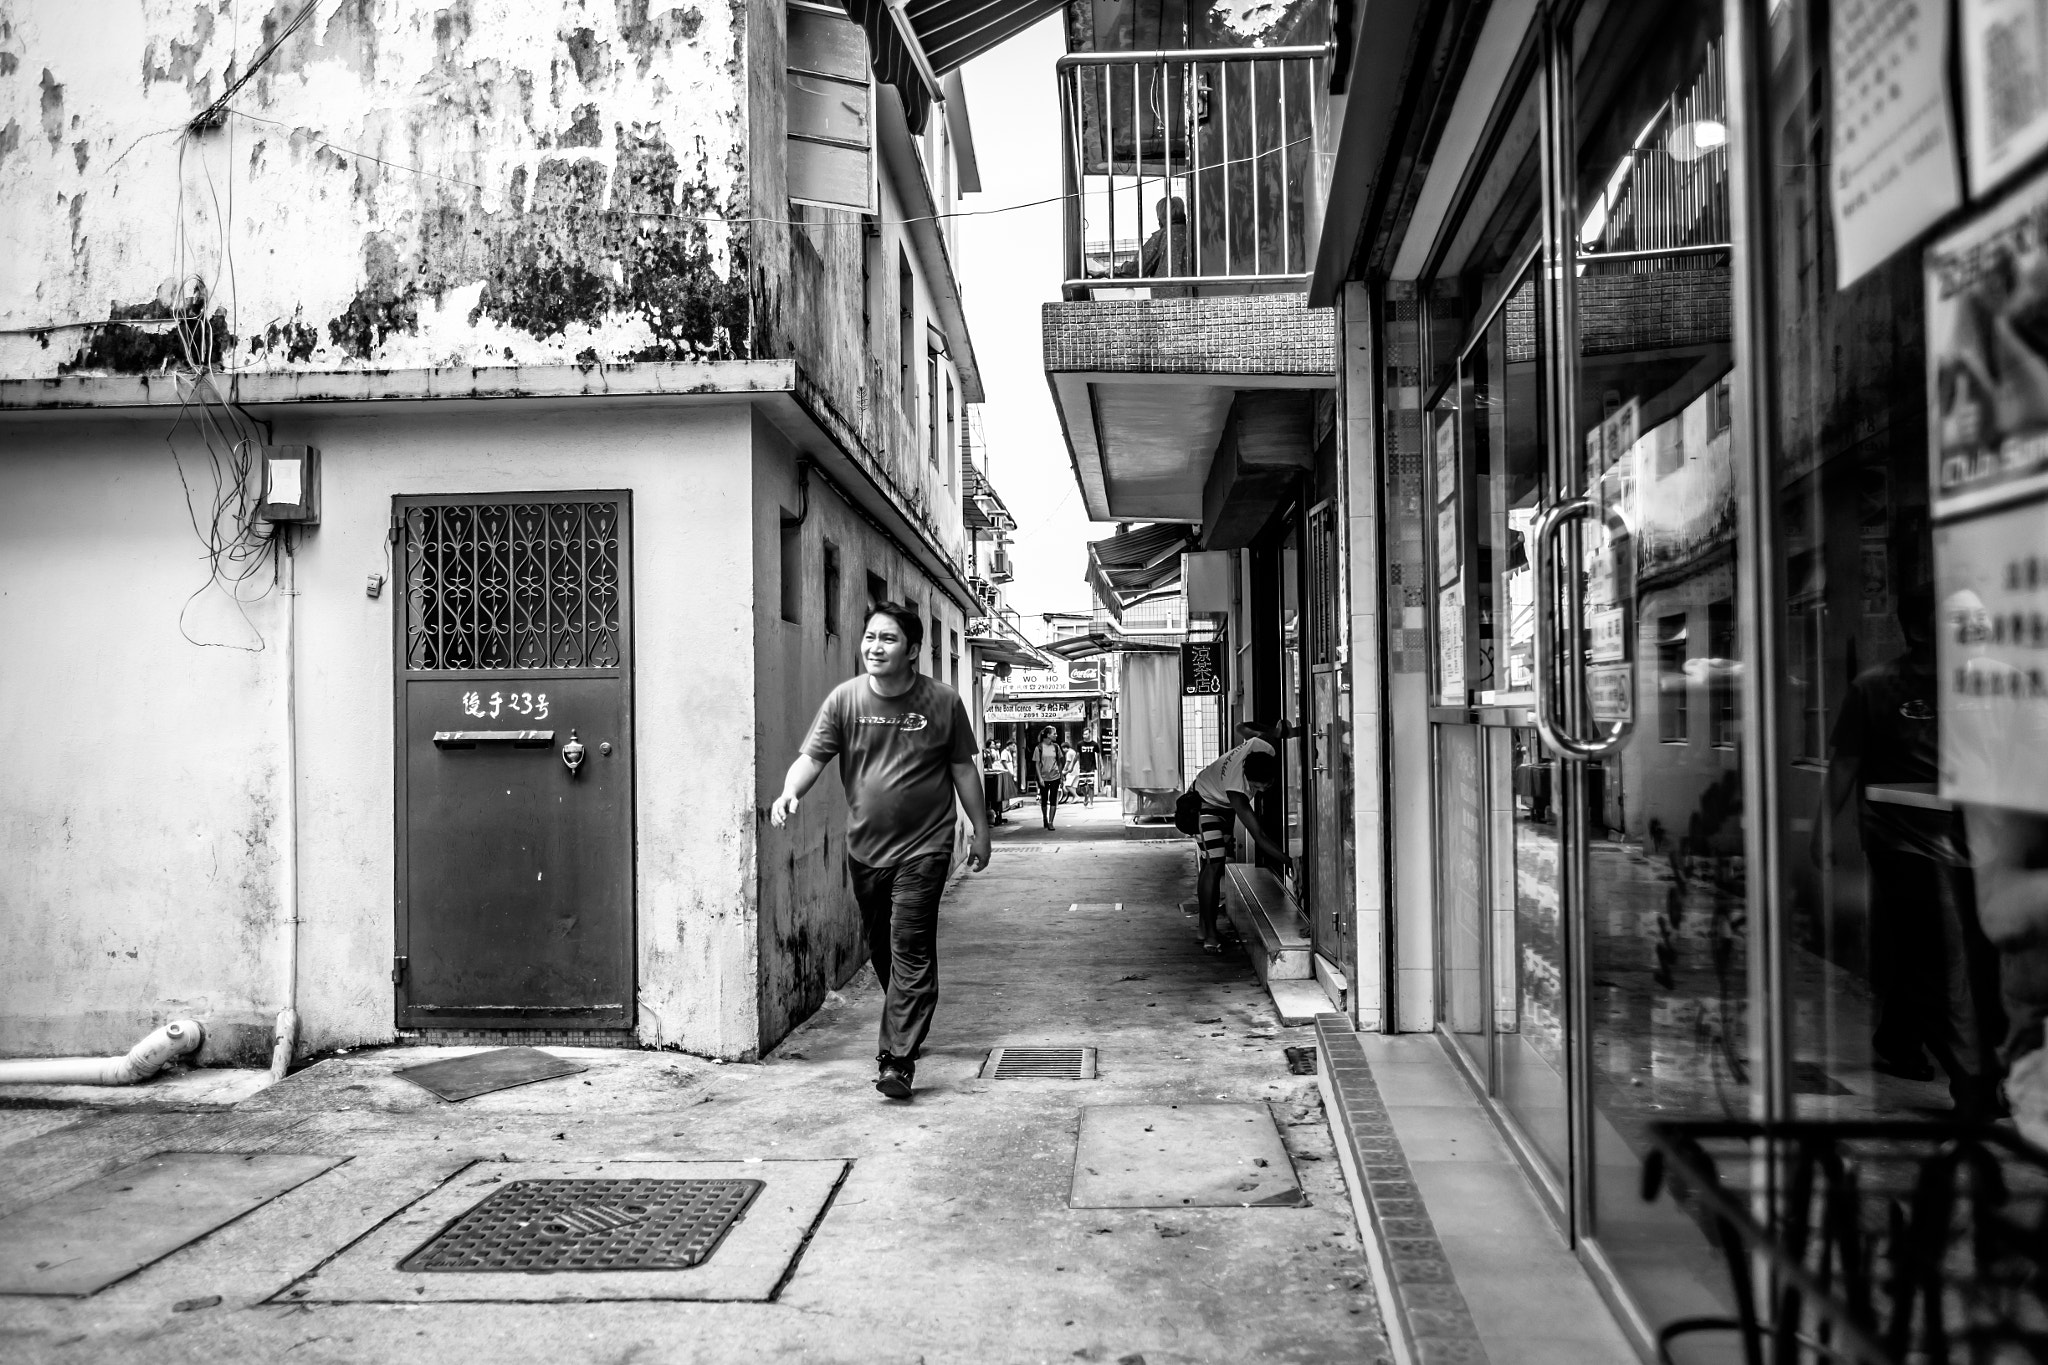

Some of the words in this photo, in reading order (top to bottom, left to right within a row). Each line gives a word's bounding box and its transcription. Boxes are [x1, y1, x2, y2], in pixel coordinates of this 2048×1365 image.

[1191, 645, 1213, 693] 涼茶店
[1022, 675, 1038, 683] WO
[1046, 675, 1059, 683] HO
[994, 704, 1002, 713] the
[1003, 703, 1014, 713] Boat
[1014, 704, 1032, 713] licence
